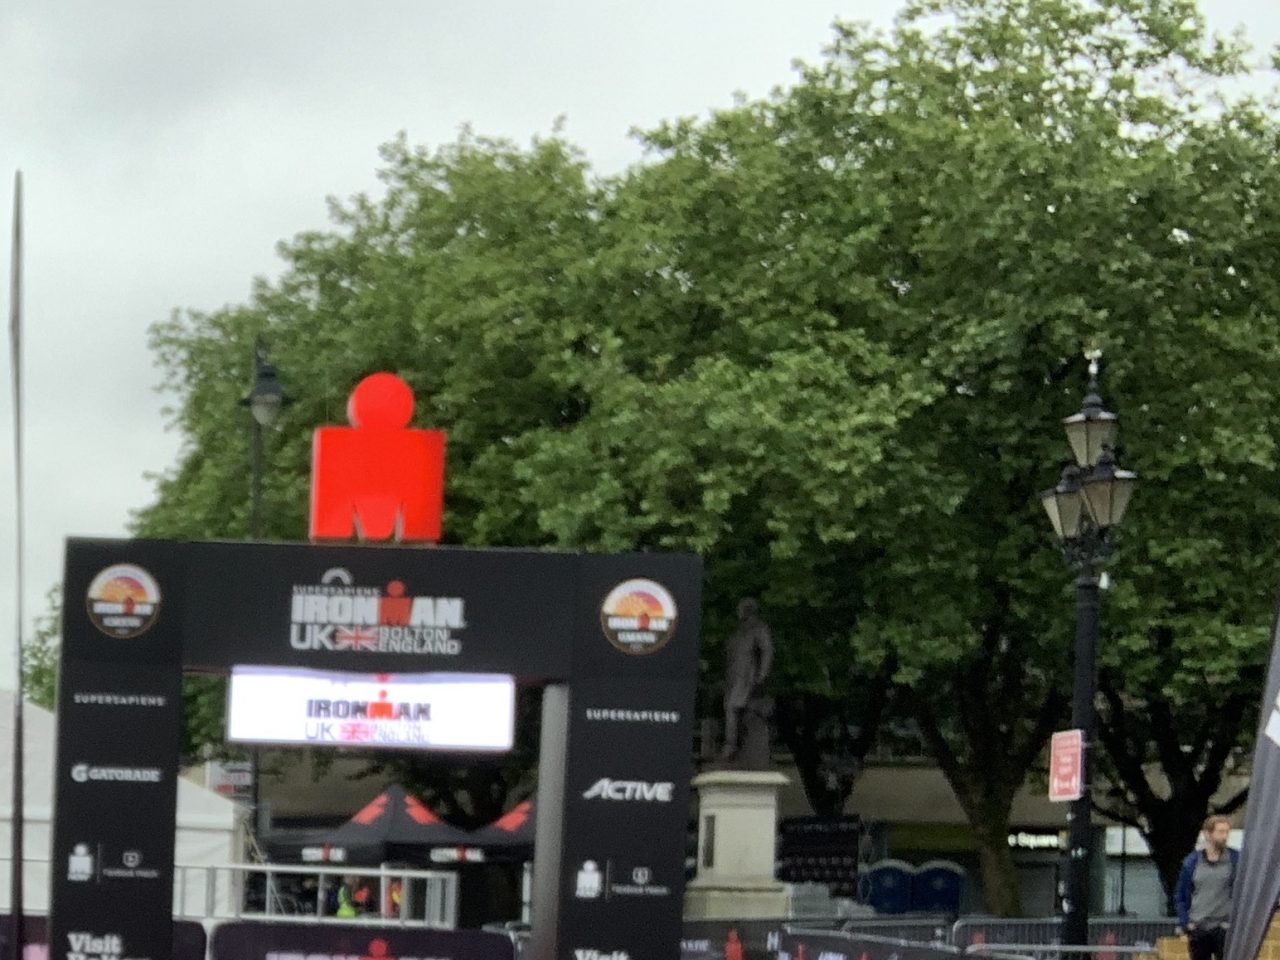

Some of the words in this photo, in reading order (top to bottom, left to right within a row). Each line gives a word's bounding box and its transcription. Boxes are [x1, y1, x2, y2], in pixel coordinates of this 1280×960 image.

[291, 580, 466, 629] IRONMAN
[290, 624, 334, 651] UK
[379, 627, 448, 641] BOLTON
[379, 639, 462, 655] ENGLAND
[73, 693, 166, 706] SUPERSAPIENS
[306, 689, 432, 721] IRONMAN
[586, 708, 680, 723] SUPERSAPIENS
[305, 722, 334, 741] UK
[88, 767, 163, 782] GATORADE
[582, 777, 675, 802] ACTIVE
[67, 932, 122, 954] Visit
